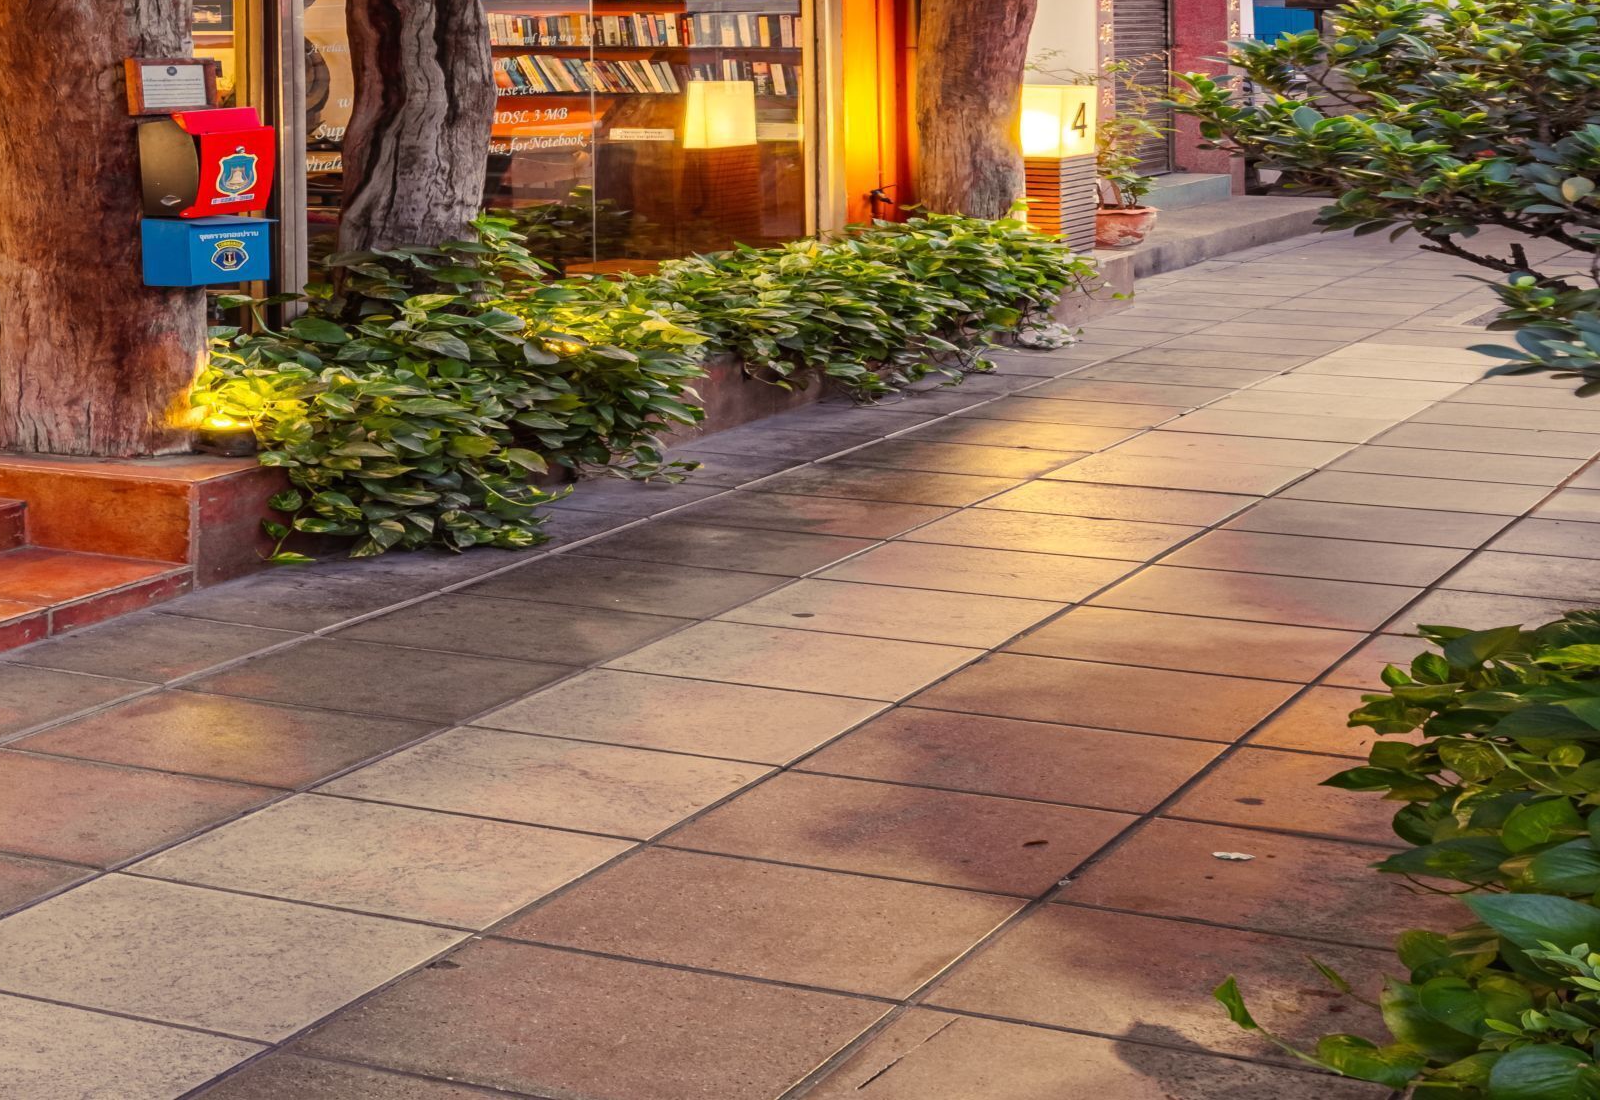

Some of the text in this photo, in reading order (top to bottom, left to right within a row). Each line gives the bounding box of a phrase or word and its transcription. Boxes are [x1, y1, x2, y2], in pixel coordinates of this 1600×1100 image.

[532, 109, 542, 122] 3
[543, 106, 569, 121] MB
[1071, 102, 1088, 138] 4
